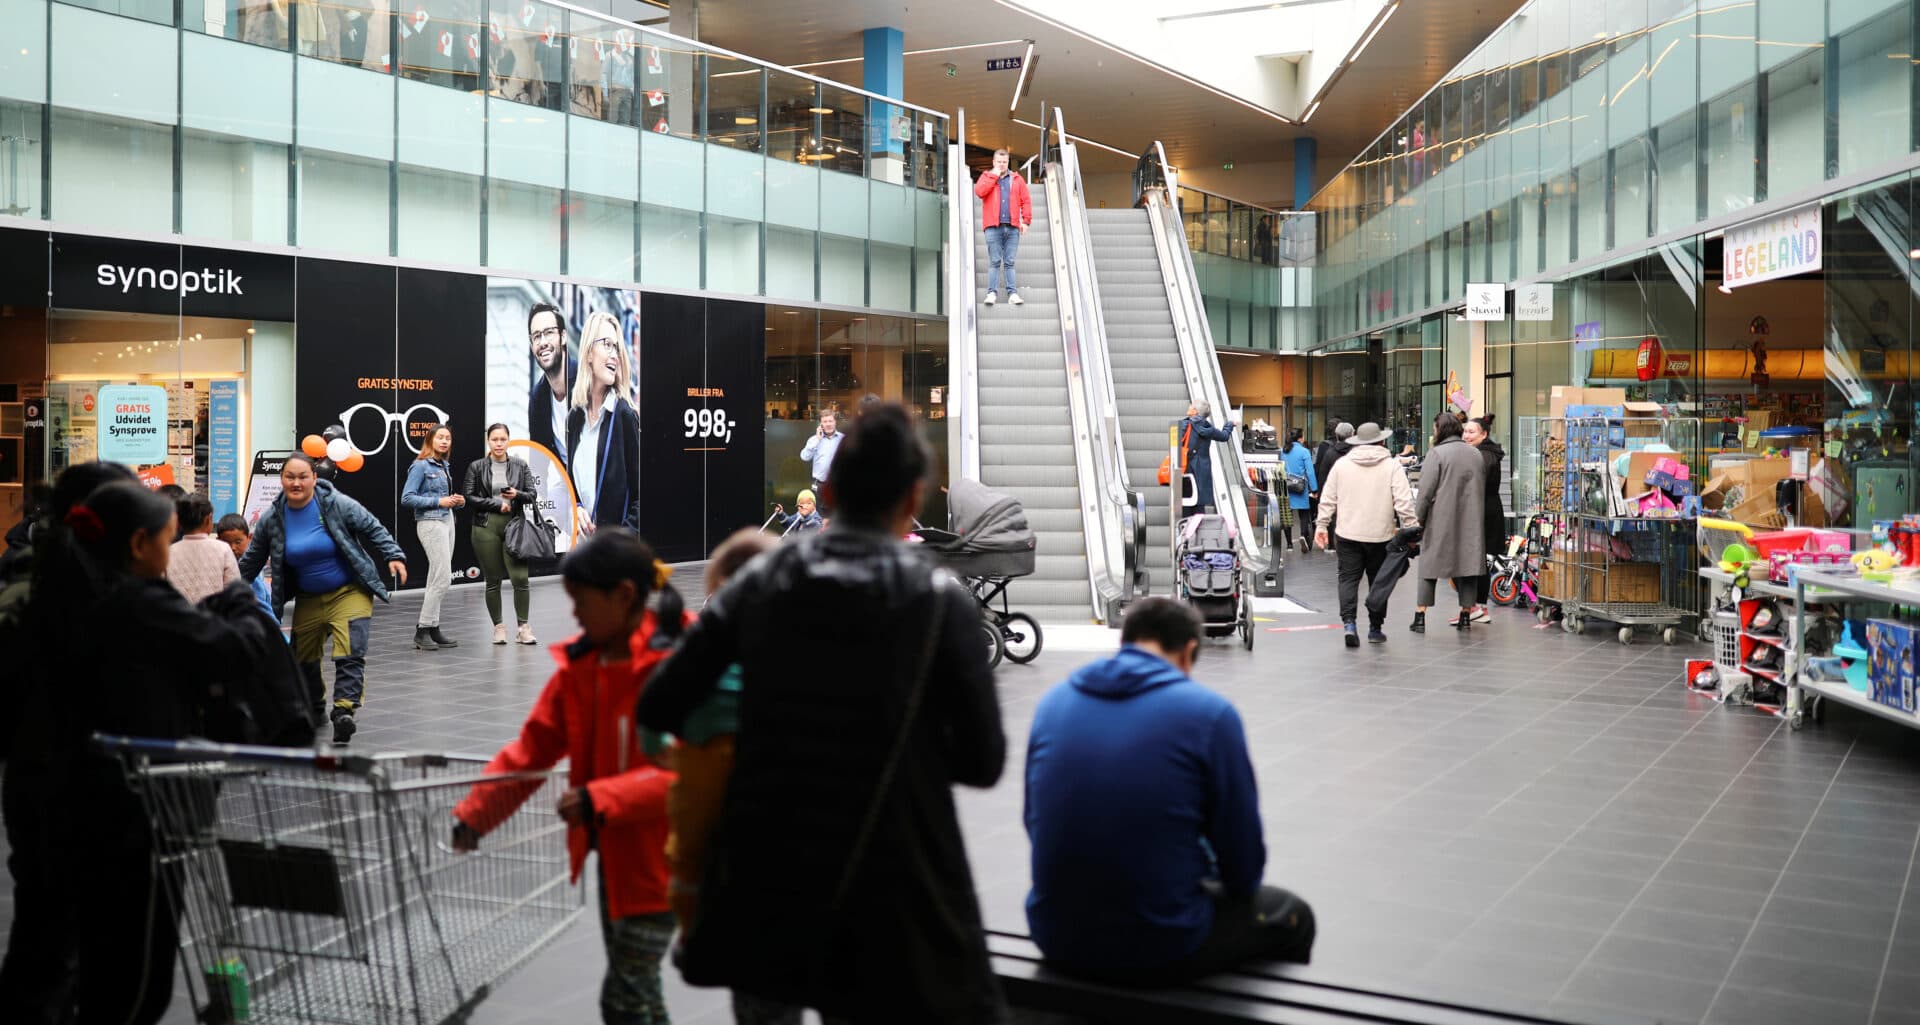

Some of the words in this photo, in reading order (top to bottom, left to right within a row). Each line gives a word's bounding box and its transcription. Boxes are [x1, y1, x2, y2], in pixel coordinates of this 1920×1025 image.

[1725, 229, 1818, 281] LEGELAND
[97, 264, 243, 297] synoptik
[1470, 306, 1501, 314] Shaved
[1667, 361, 1689, 371] LEGO
[357, 378, 389, 389] GRATIS
[391, 379, 433, 391] SYNSTJEK
[712, 388, 725, 398] FRA
[116, 404, 151, 413] GRATIS
[115, 415, 151, 424] Udvidet
[109, 425, 157, 437] Synsprøve
[684, 408, 736, 444] 998,-
[262, 461, 284, 471] Synop
